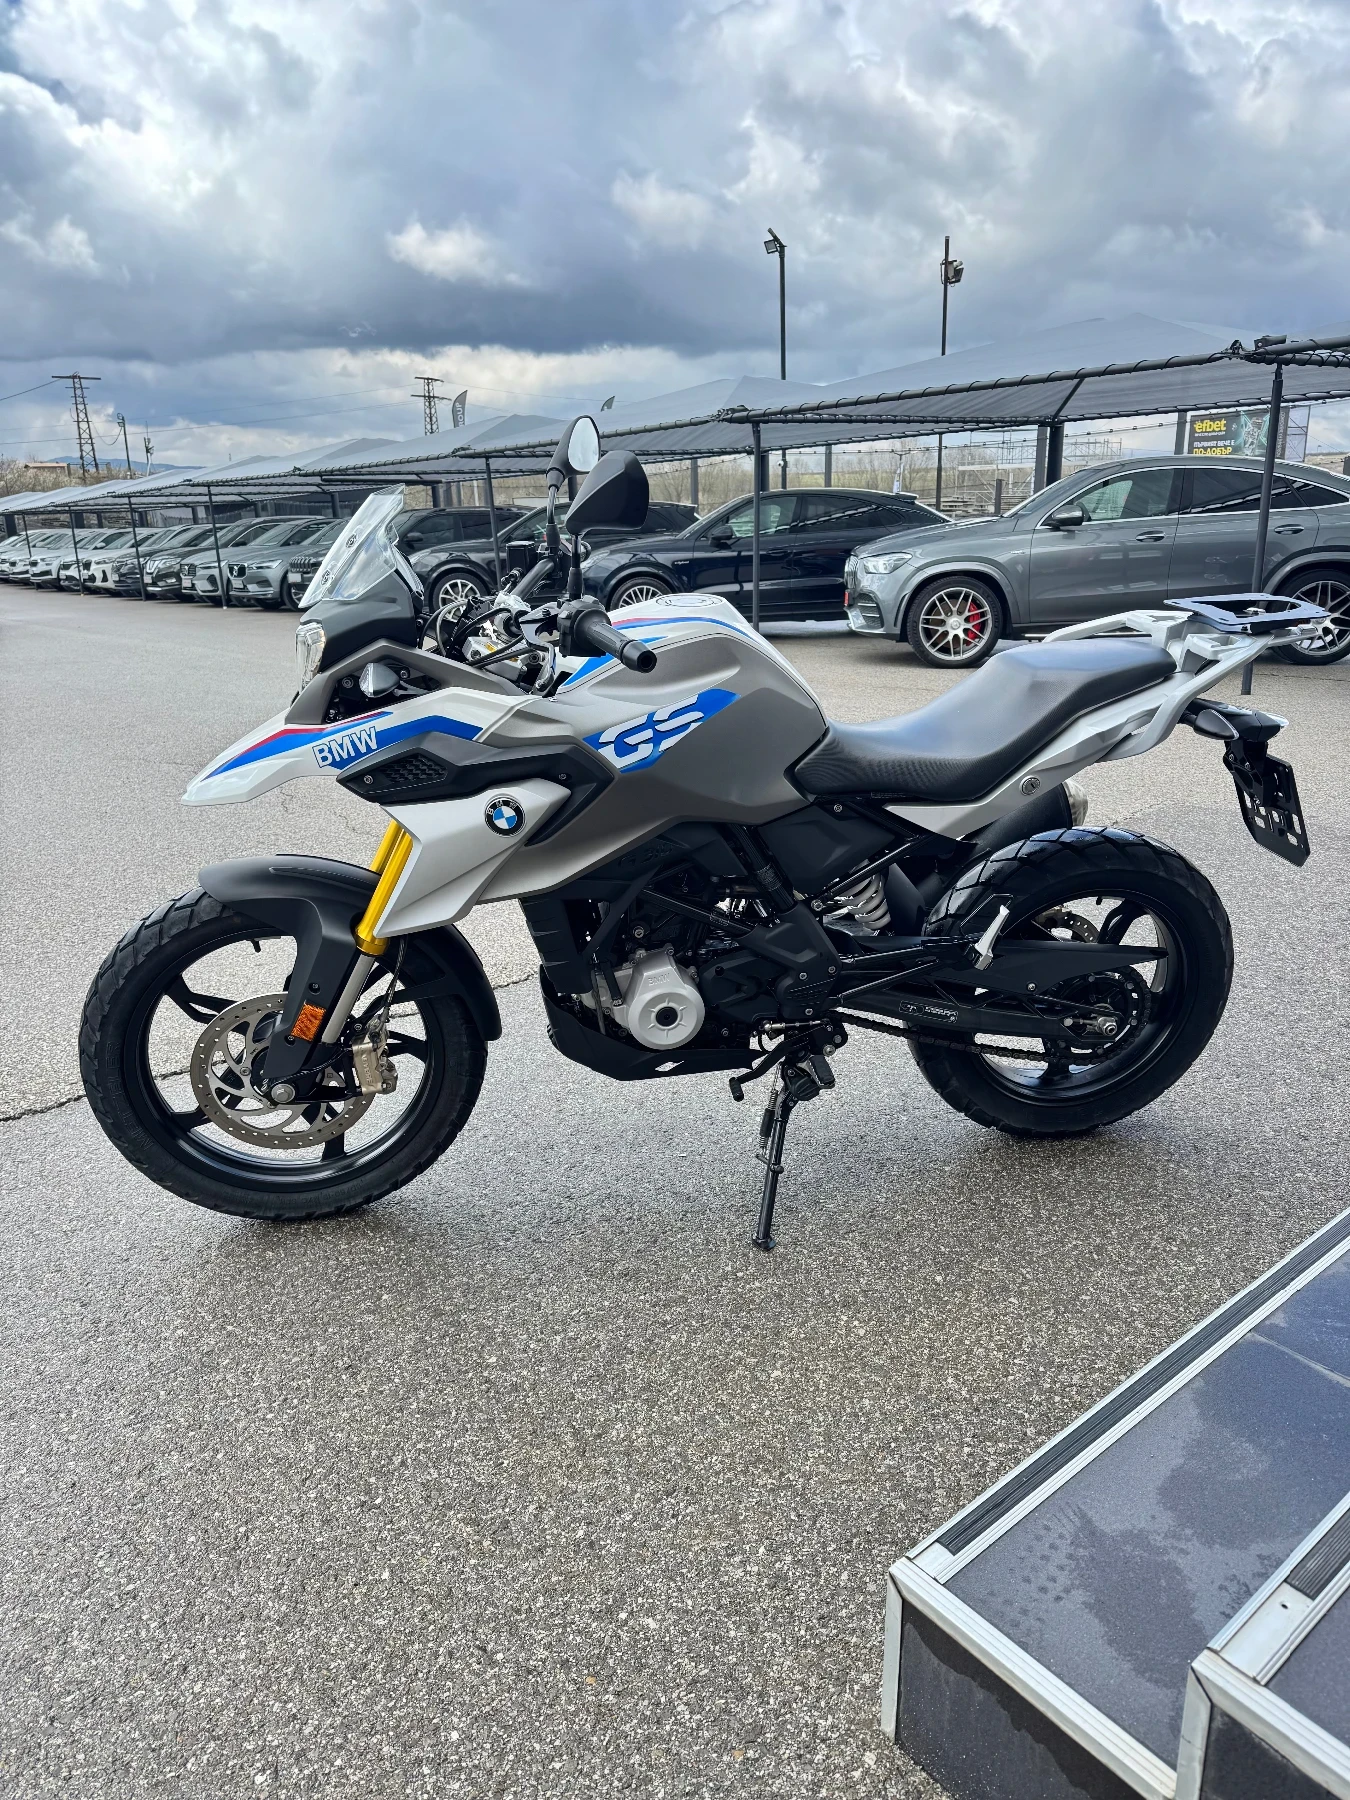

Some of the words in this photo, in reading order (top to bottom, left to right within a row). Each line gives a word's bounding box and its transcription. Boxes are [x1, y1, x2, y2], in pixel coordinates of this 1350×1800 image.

[1194, 418, 1226, 432] efbet
[598, 694, 704, 769] GS
[312, 726, 378, 768] BMW
[648, 973, 670, 987] BMW
